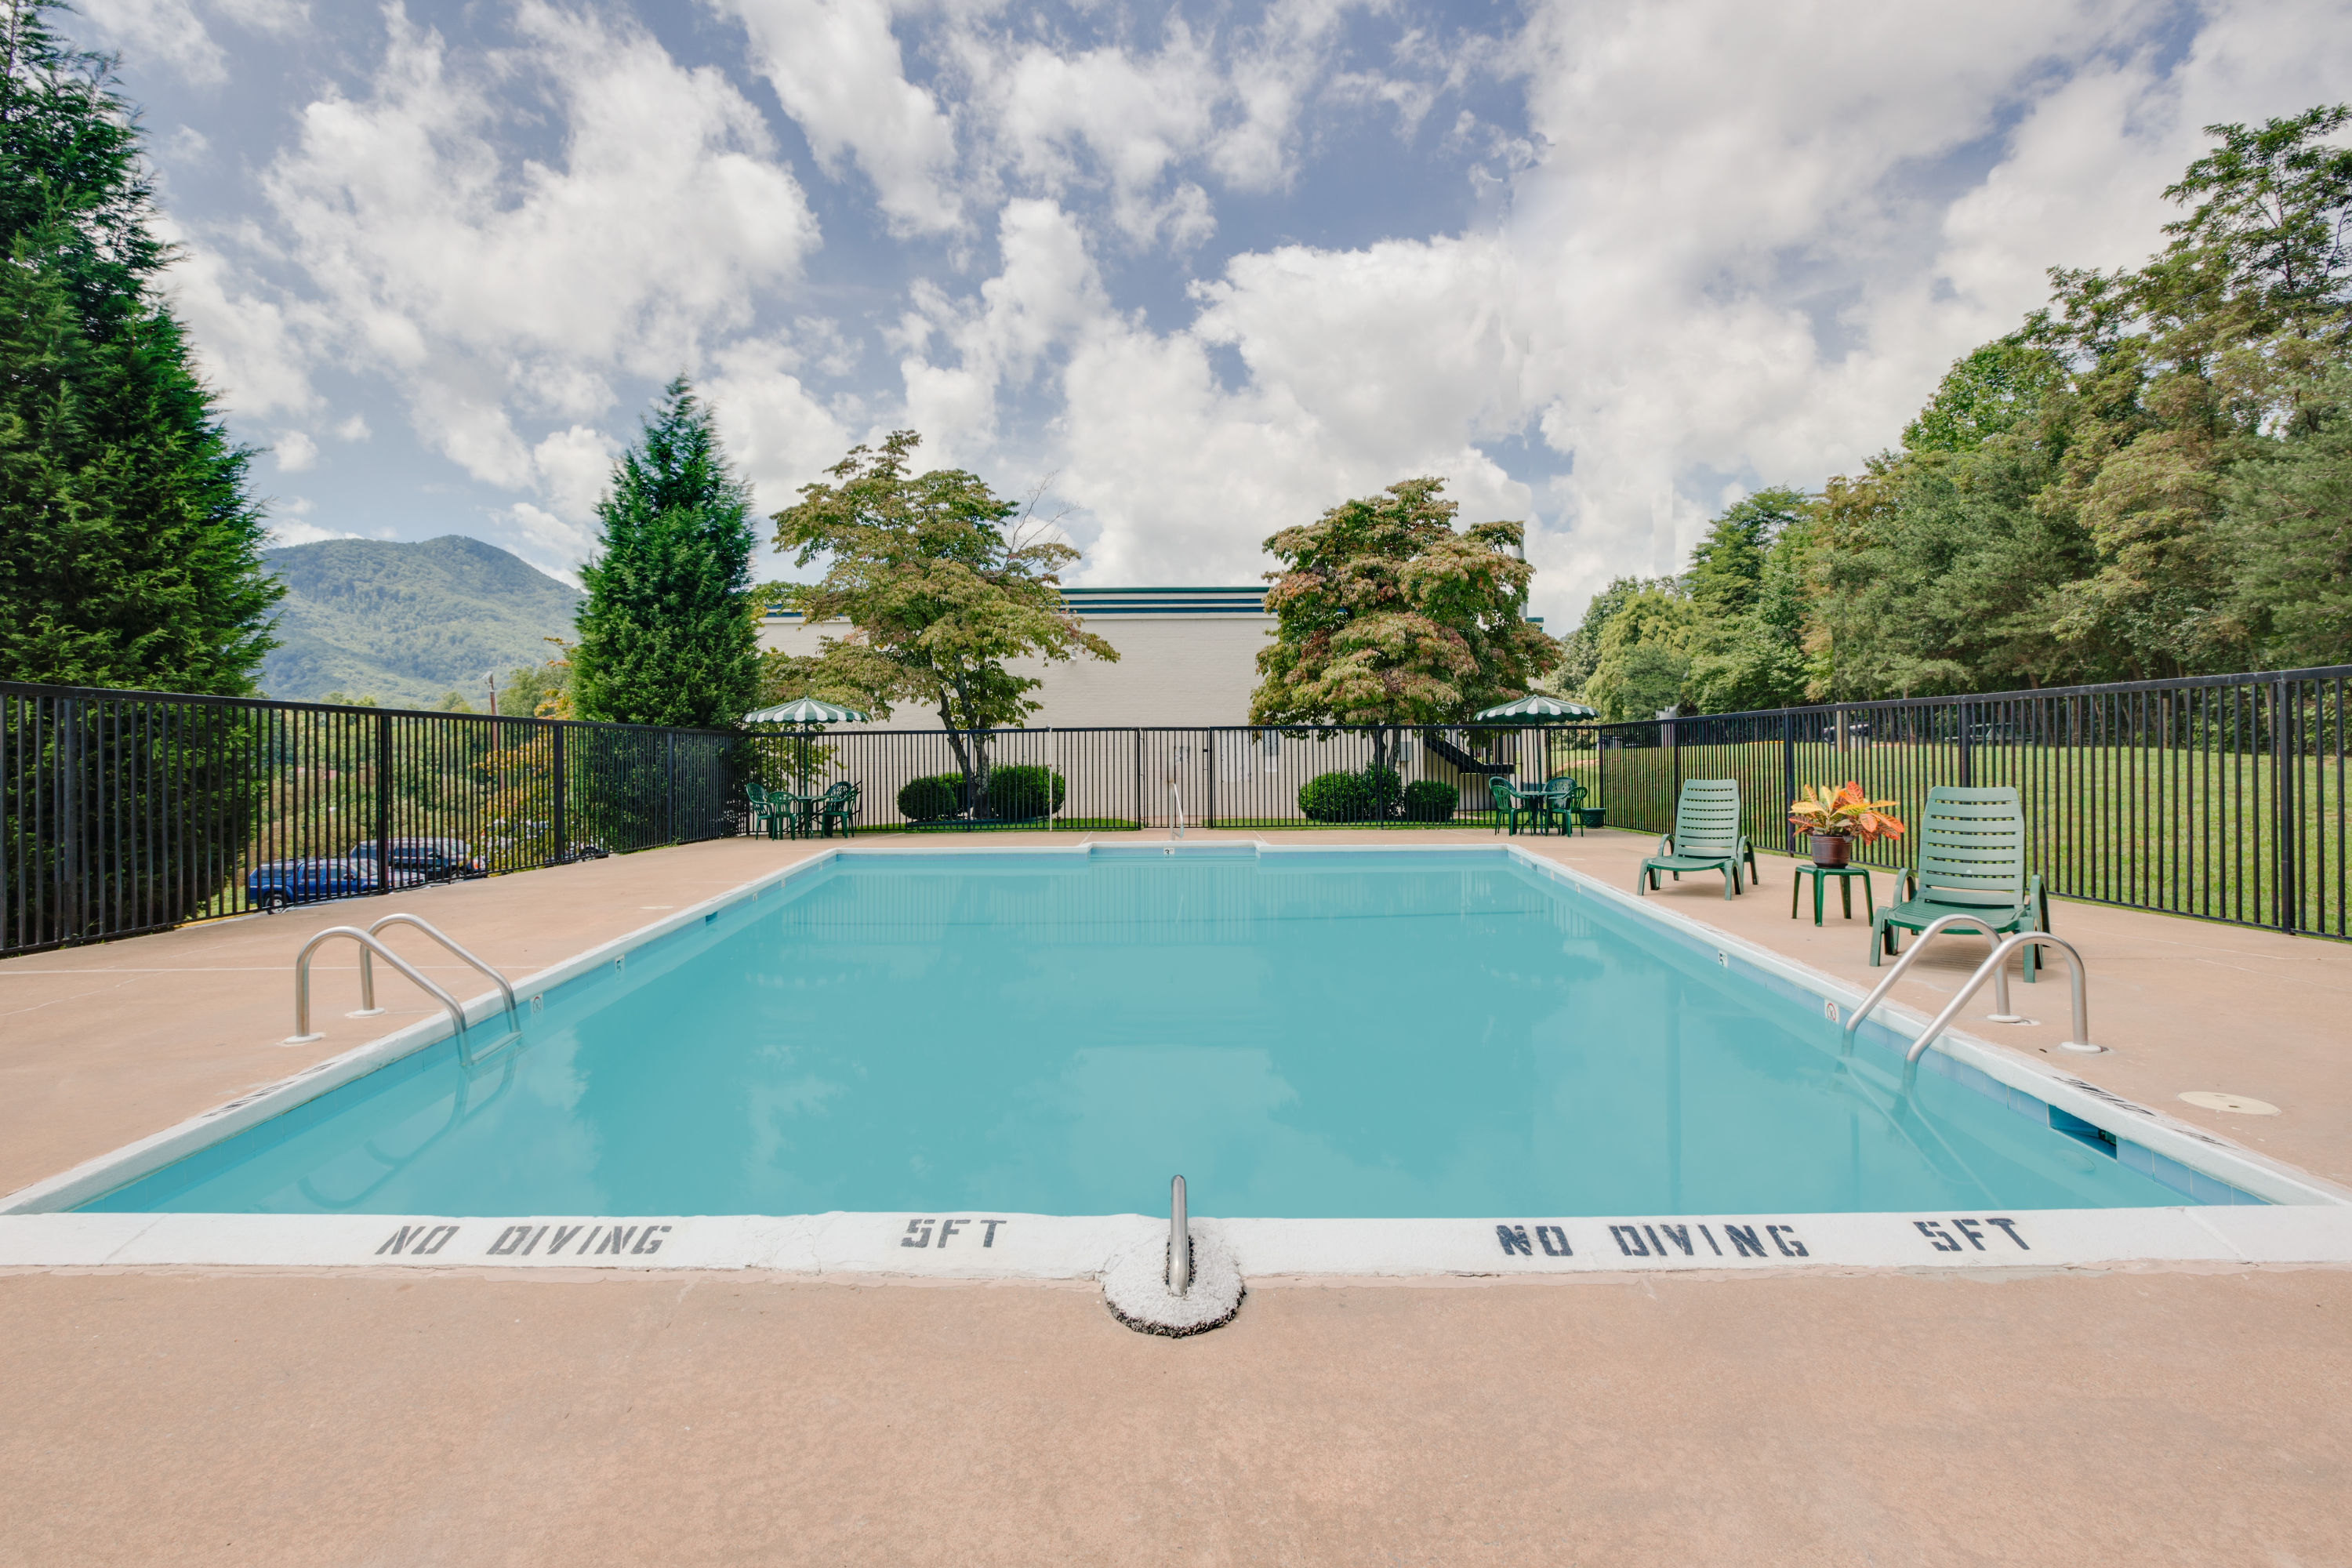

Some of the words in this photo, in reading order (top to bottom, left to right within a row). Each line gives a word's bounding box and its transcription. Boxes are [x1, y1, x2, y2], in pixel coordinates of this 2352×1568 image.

[375, 1225, 460, 1254] NO
[488, 1225, 672, 1254] DIVING
[1496, 1224, 1573, 1257] NO
[1609, 1224, 1810, 1258] DIVING
